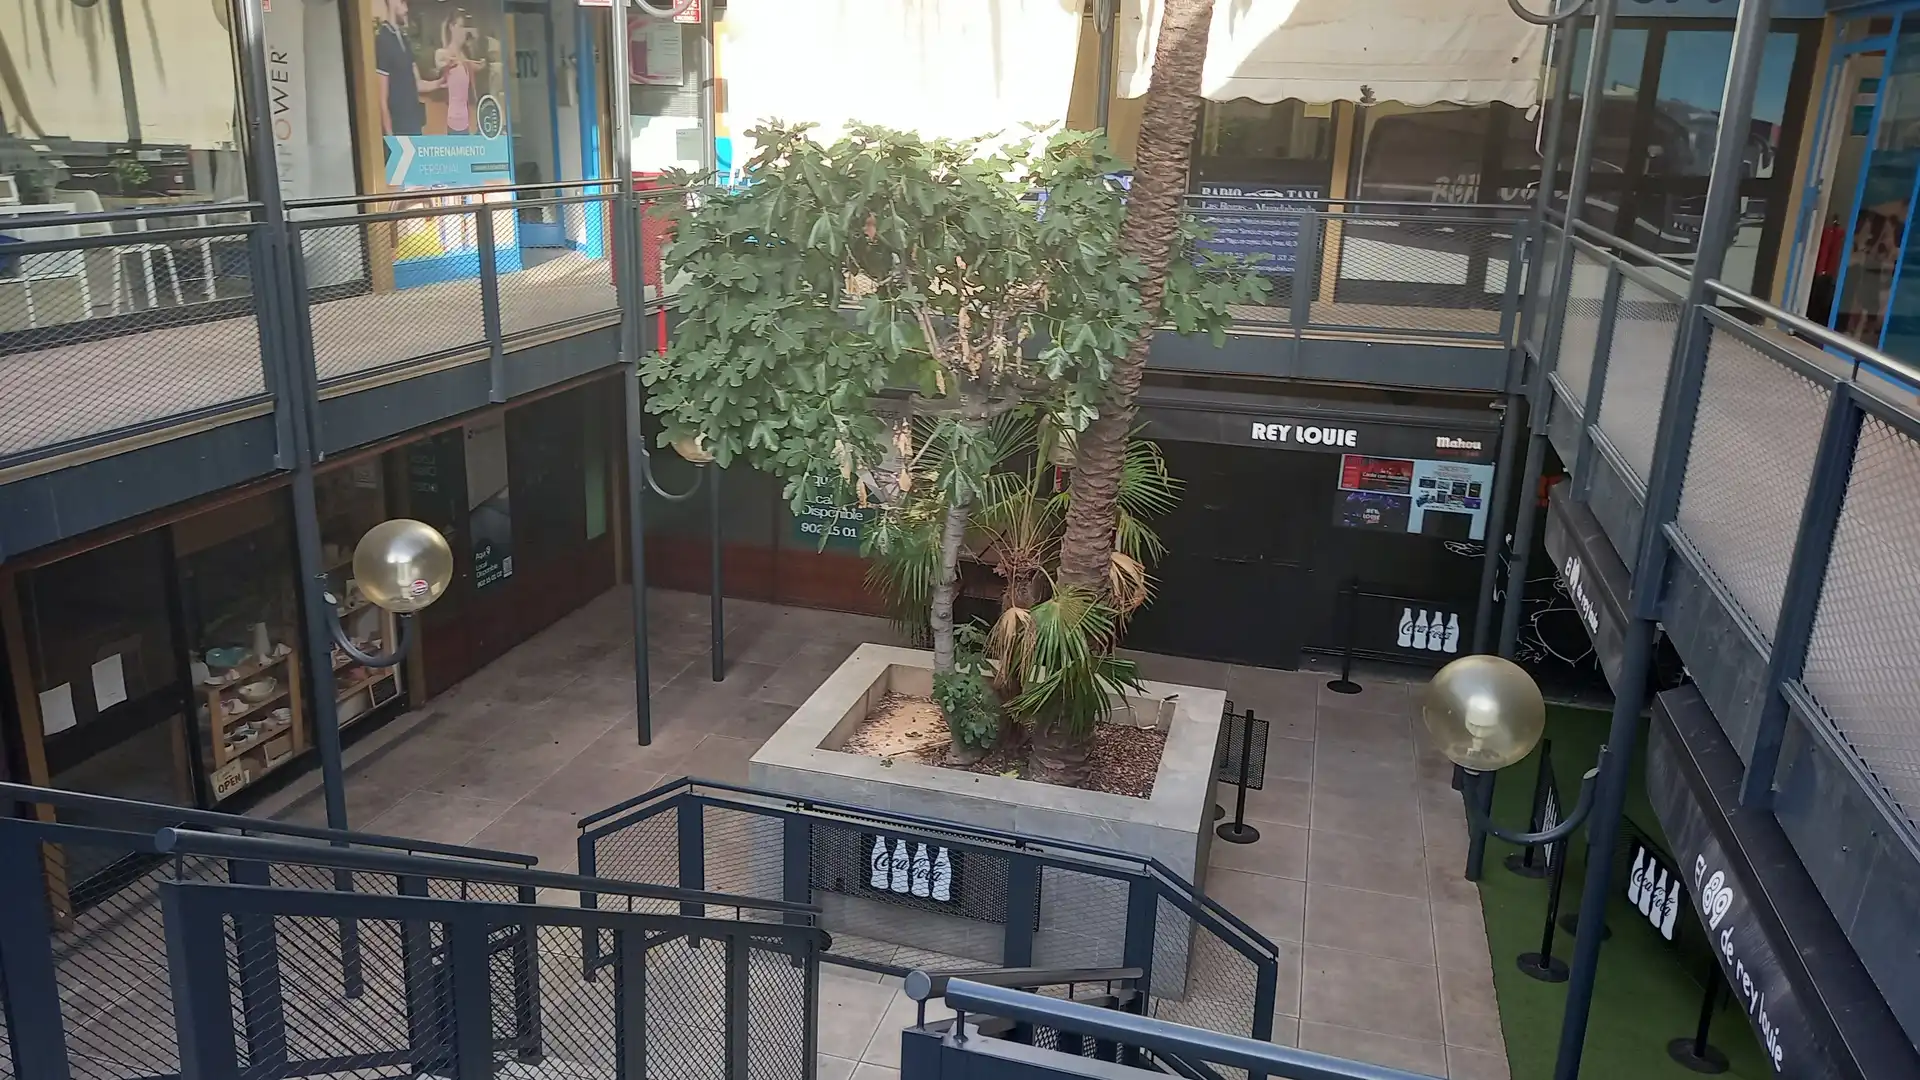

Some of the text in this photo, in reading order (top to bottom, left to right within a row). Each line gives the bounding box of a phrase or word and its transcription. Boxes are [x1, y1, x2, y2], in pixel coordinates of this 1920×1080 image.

[418, 146, 486, 157] ENTRENAMIENTO
[419, 163, 461, 175] PERSONAL
[1201, 187, 1243, 197] RADIO
[1252, 422, 1358, 448] REY LOUIE
[1436, 436, 1482, 451] Mahou
[842, 528, 857, 538] 01
[218, 773, 242, 793] OPEN
[1721, 927, 1735, 966] de
[1736, 958, 1759, 1015] rey
[1758, 992, 1784, 1073] louie
